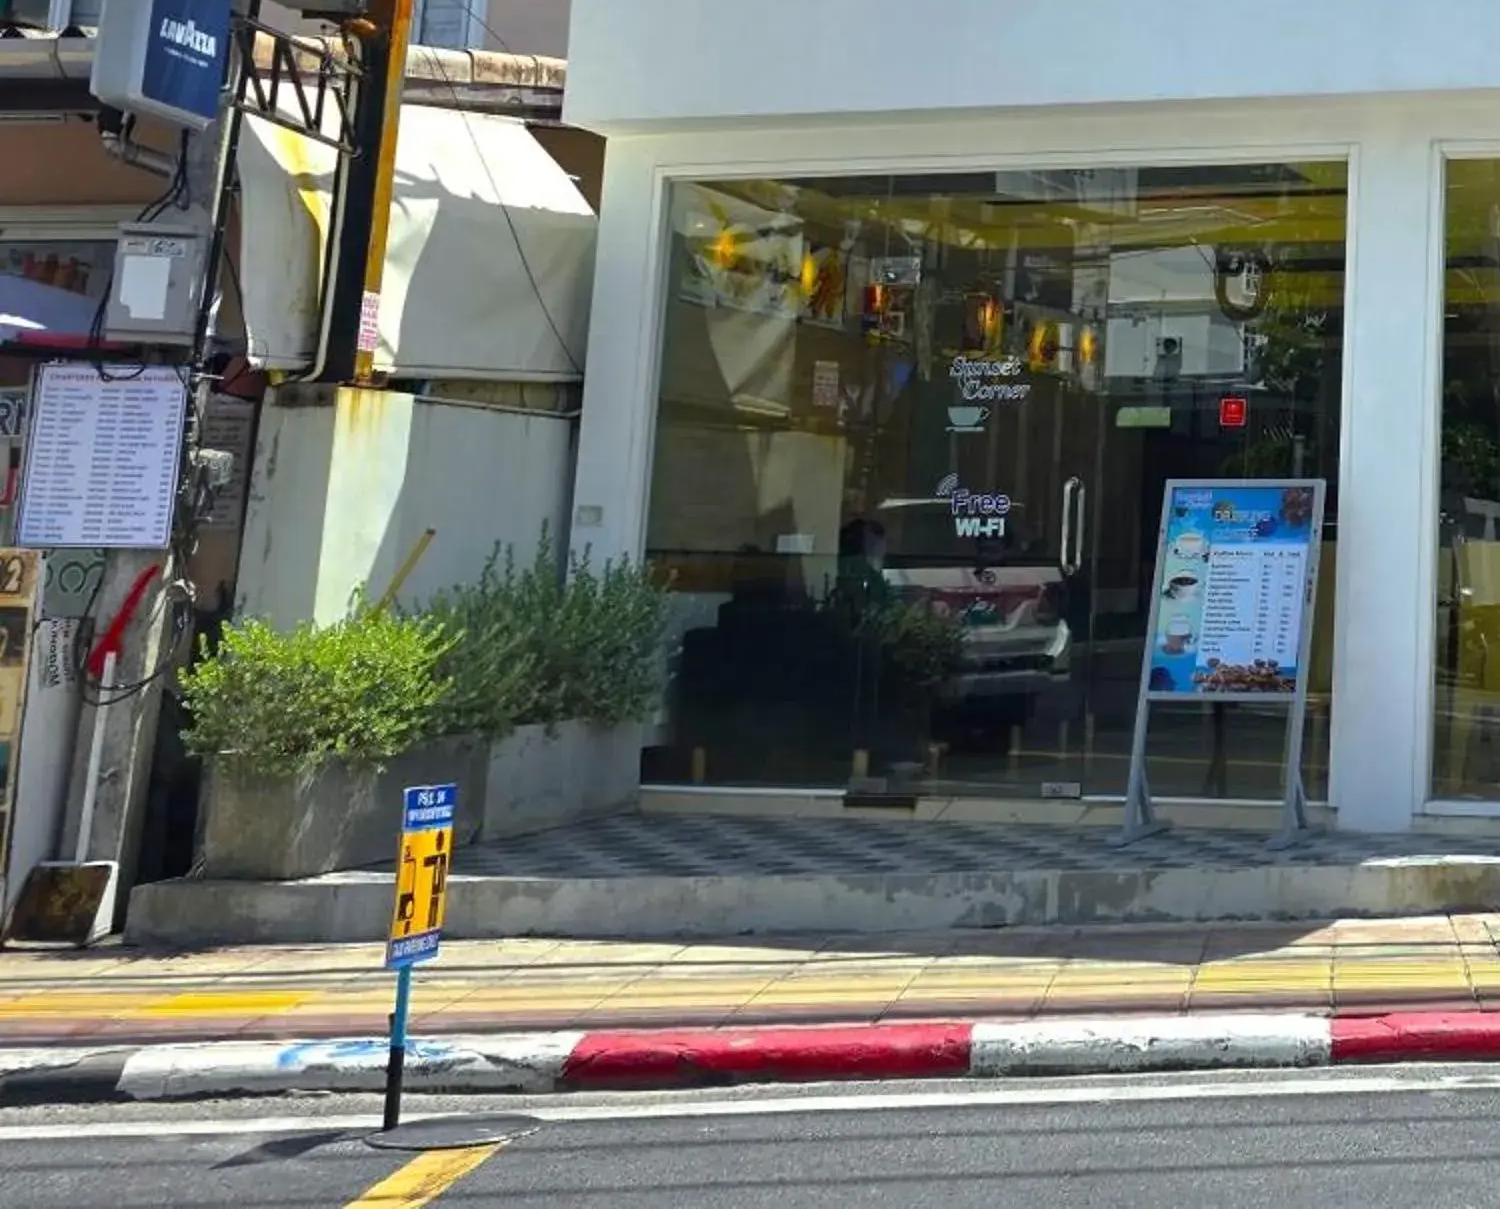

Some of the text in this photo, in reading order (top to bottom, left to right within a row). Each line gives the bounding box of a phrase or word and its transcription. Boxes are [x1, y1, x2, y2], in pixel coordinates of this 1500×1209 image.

[950, 355, 1023, 377] Sunset
[961, 380, 1031, 400] Corner
[951, 488, 1011, 515] Free
